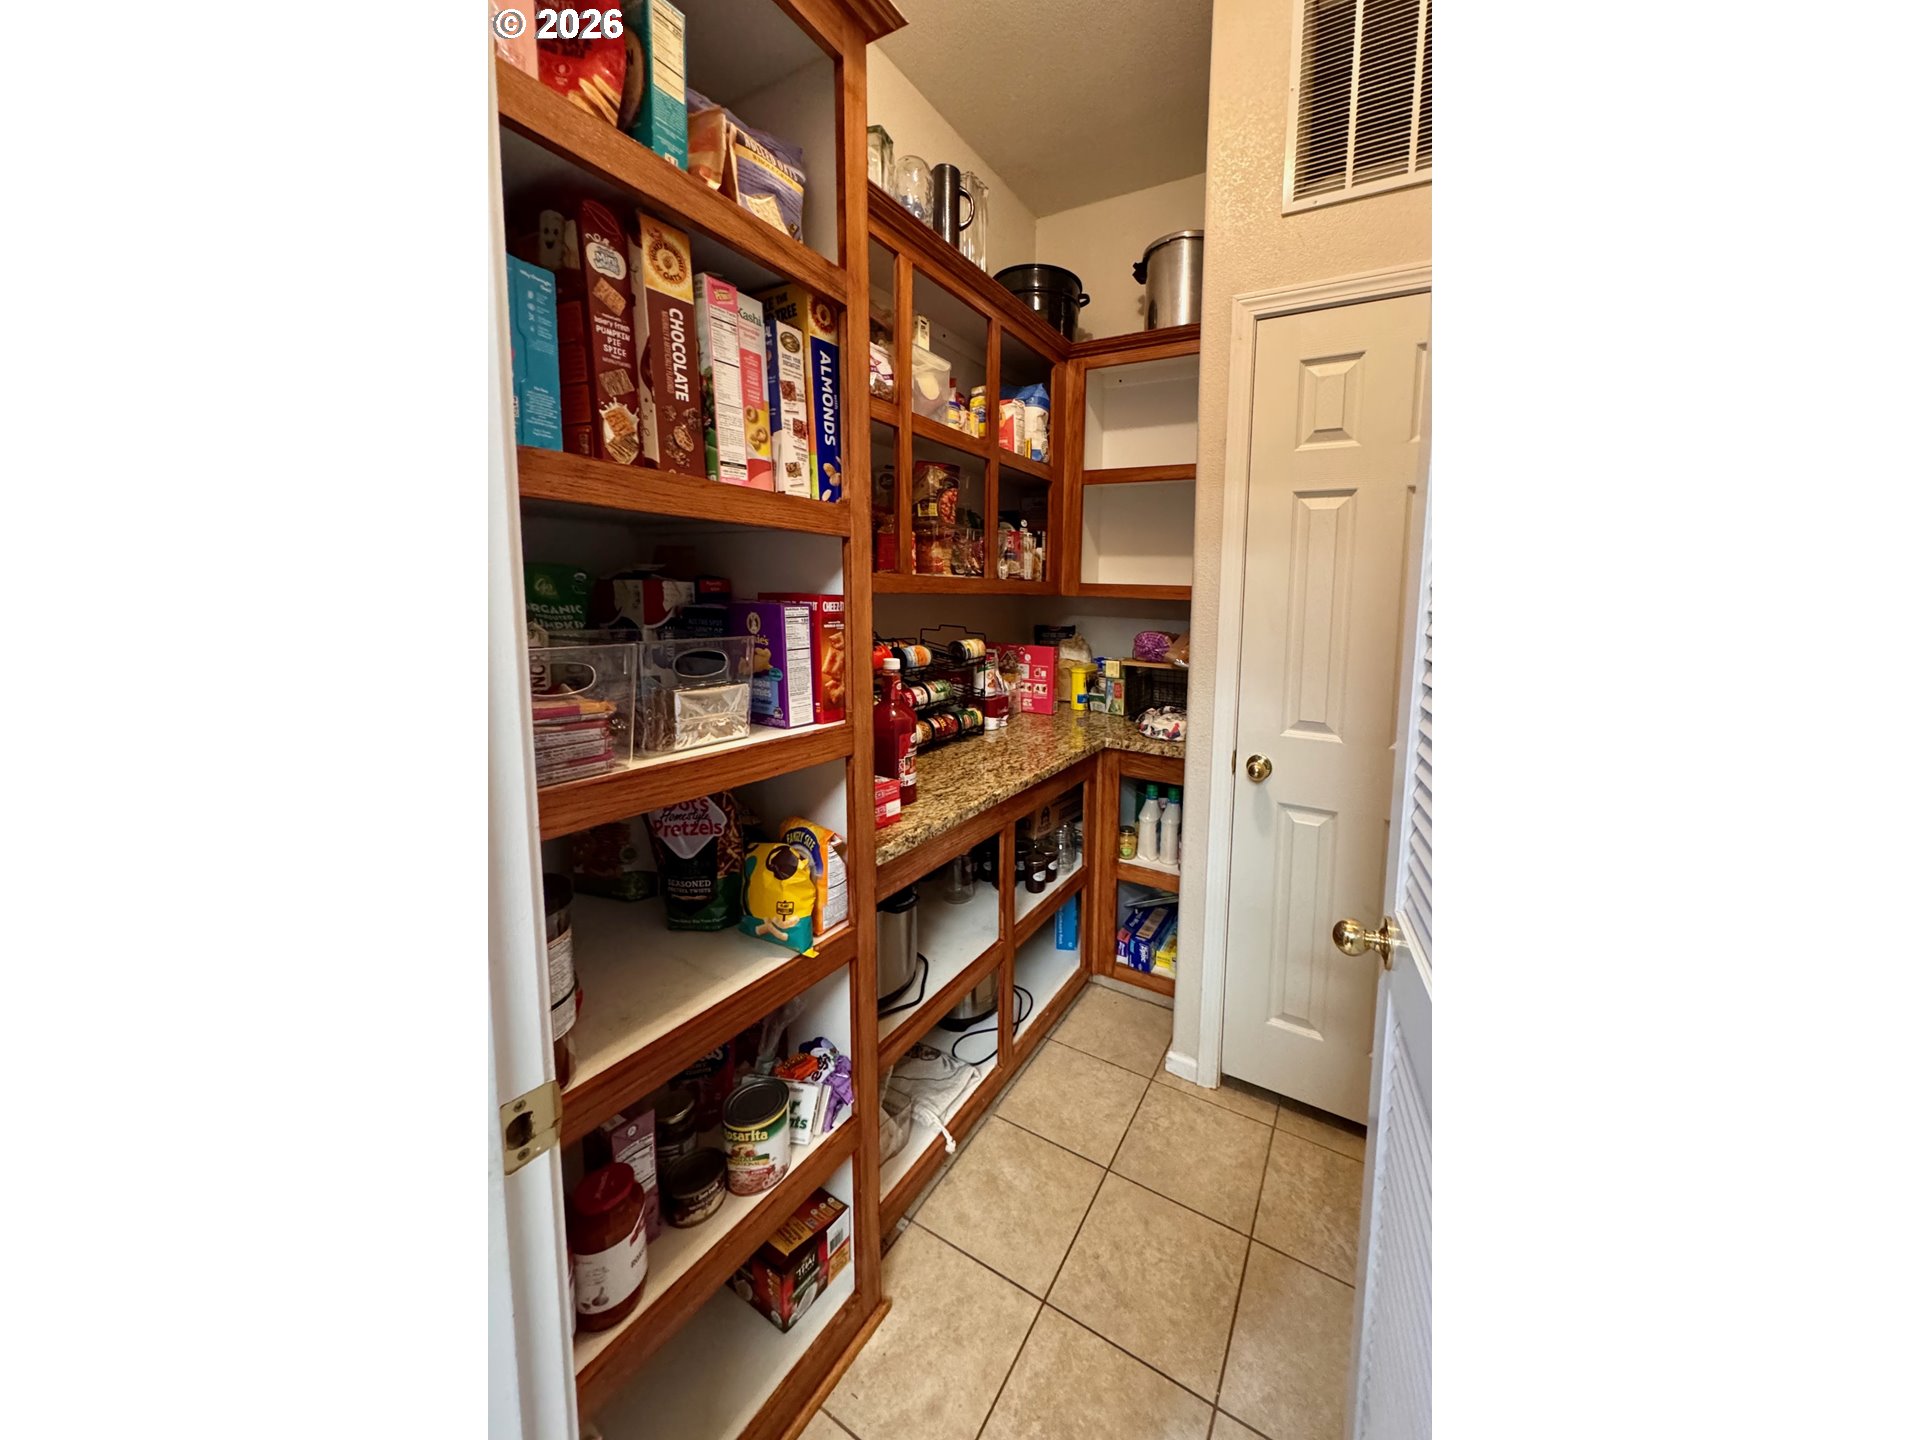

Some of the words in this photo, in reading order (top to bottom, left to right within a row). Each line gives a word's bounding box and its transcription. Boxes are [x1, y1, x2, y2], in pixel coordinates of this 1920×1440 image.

[738, 307, 763, 327] Kashi
[595, 324, 631, 342] PUMPKIN
[606, 336, 622, 347] PIE
[603, 344, 627, 358] SPICE
[669, 308, 690, 402] CHOCOLATE
[820, 350, 836, 446] ALMONDS
[660, 808, 709, 822] Homestyle
[654, 819, 723, 837] Pretzels
[803, 834, 816, 851] SIZE
[667, 878, 712, 888] SEASONED
